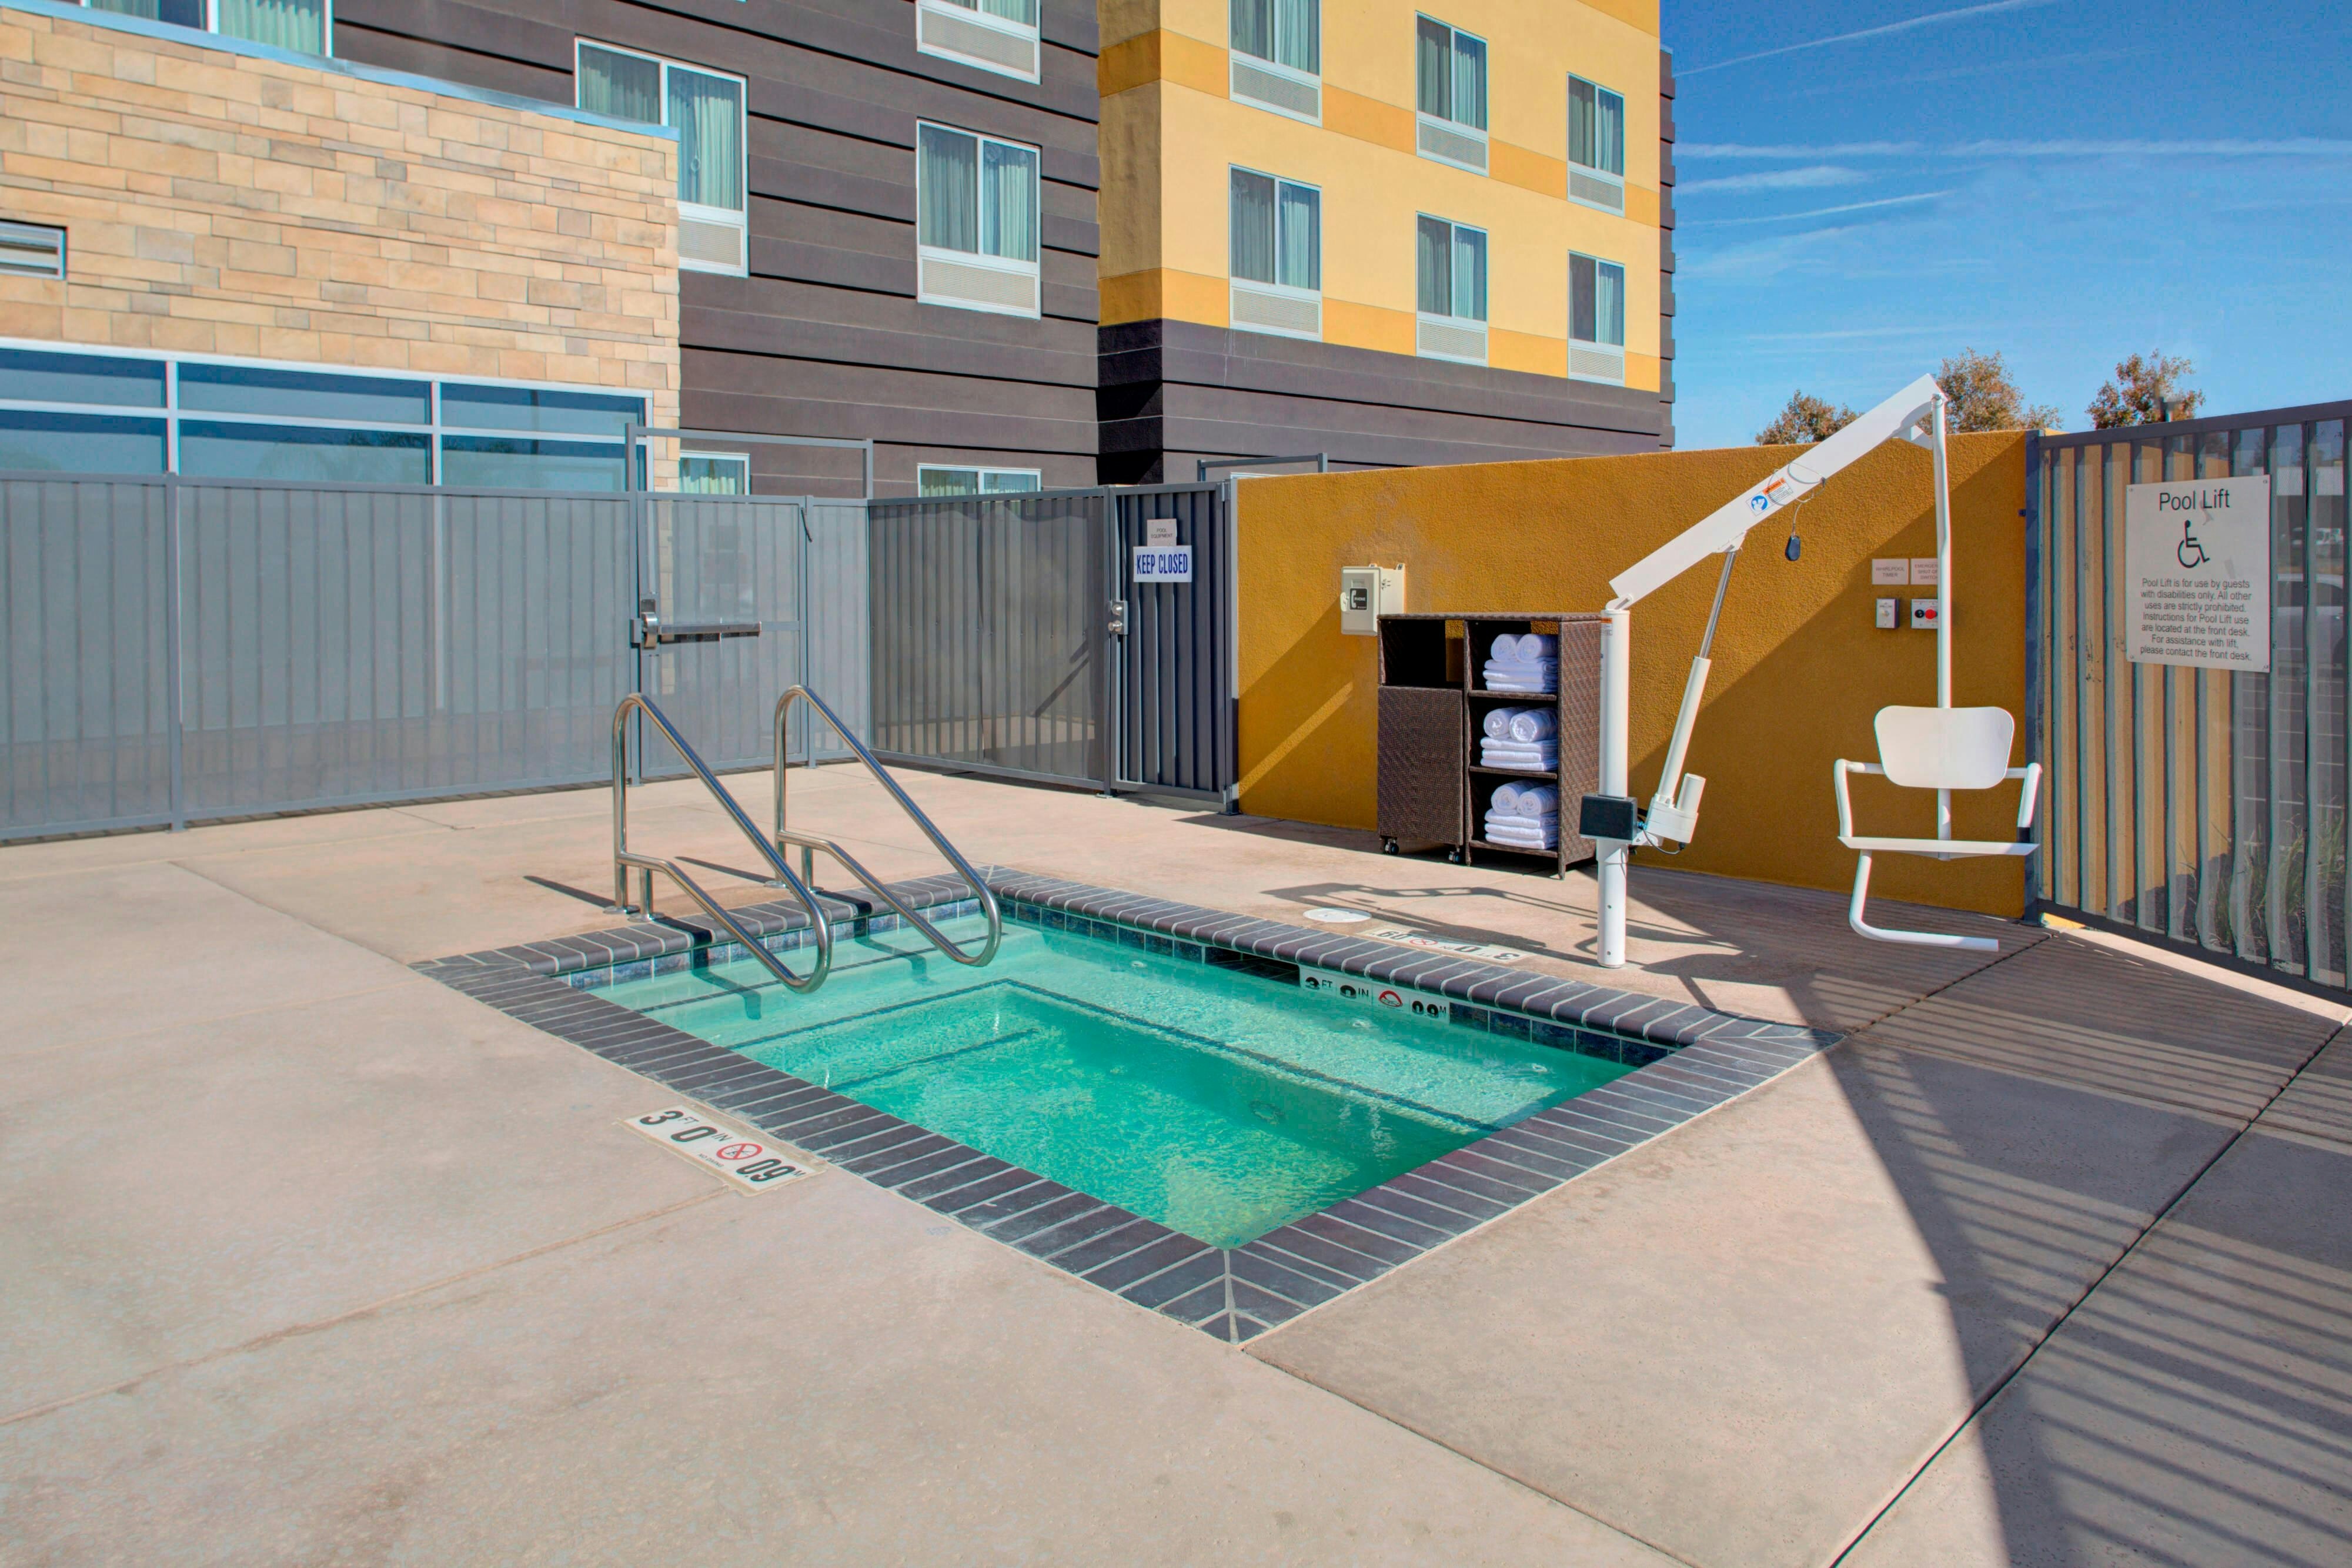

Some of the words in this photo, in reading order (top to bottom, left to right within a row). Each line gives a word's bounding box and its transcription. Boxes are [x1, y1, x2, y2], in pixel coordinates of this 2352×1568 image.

[2159, 490, 2196, 511] Pool
[2203, 489, 2230, 509] Lift
[1137, 555, 1155, 574] KEEP
[1158, 554, 1188, 574] CLOSED
[2142, 578, 2158, 587] Pool
[2160, 579, 2172, 587] Lift
[2174, 579, 2180, 587] is
[2181, 579, 2192, 587] for
[2210, 579, 2220, 590] by
[2222, 580, 2250, 590] guests
[2157, 590, 2196, 599] disabilities
[2197, 591, 2216, 601] only.
[2217, 591, 2228, 600] All
[2230, 591, 2251, 600] other
[2178, 602, 2202, 613] strictly
[2204, 603, 2246, 613] prohibited.
[2143, 612, 2185, 621] Instructions
[2186, 613, 2197, 622] for
[2199, 613, 2217, 623] Pool
[2219, 614, 2232, 624] Lift
[2154, 624, 2182, 633] located
[2184, 626, 2191, 634] at
[2193, 626, 2206, 634] the
[2208, 626, 2226, 636] front
[2228, 628, 2250, 637] desk.
[2151, 634, 2164, 643] For
[2166, 636, 2206, 646] assistance
[2208, 638, 2224, 647] with
[2226, 639, 2239, 649] lift,
[2140, 646, 2164, 655] please
[2166, 648, 2193, 657] contact
[2194, 649, 2207, 657] the
[2209, 649, 2228, 659] front
[2230, 651, 2252, 661] desk.
[1305, 977, 1320, 990] 3
[1322, 979, 1333, 988] FT
[1358, 988, 1369, 997] IN
[1439, 1005, 1446, 1014] M
[639, 1110, 684, 1125] 3
[677, 1116, 699, 1125] FT
[670, 1125, 719, 1142] 0
[713, 1132, 733, 1142] IN
